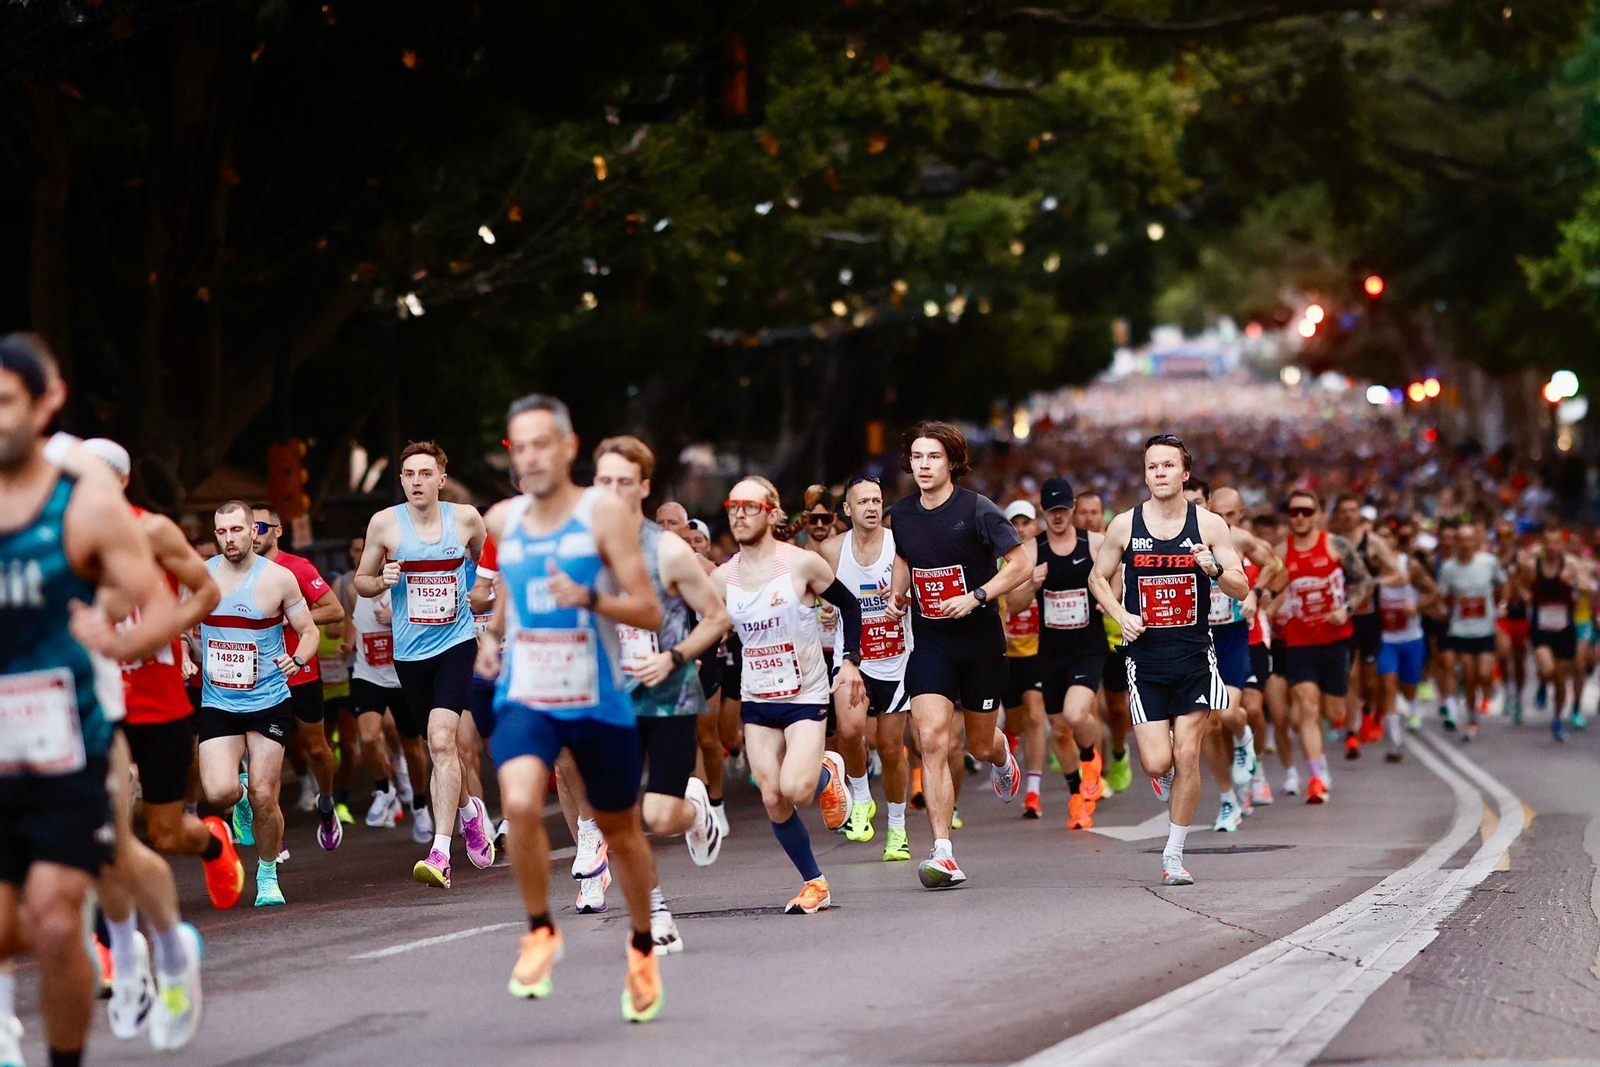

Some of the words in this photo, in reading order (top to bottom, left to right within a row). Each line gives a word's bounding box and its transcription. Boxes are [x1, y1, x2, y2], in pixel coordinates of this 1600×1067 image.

[1132, 537, 1153, 549] BRC
[1134, 554, 1195, 568] BETTER
[921, 569, 953, 578] GENERALI
[420, 576, 452, 585] GENERALI
[1152, 577, 1187, 585] GENERALI
[417, 587, 448, 597] 15524
[924, 581, 945, 592] 523
[1155, 588, 1176, 599] 510
[857, 596, 885, 607] PULSE
[742, 616, 781, 632] TARGET
[867, 626, 886, 636] 475
[218, 642, 250, 650] GENERALI
[750, 645, 786, 656] GENERALI
[216, 652, 245, 663] 14828
[749, 658, 783, 671] 15345
